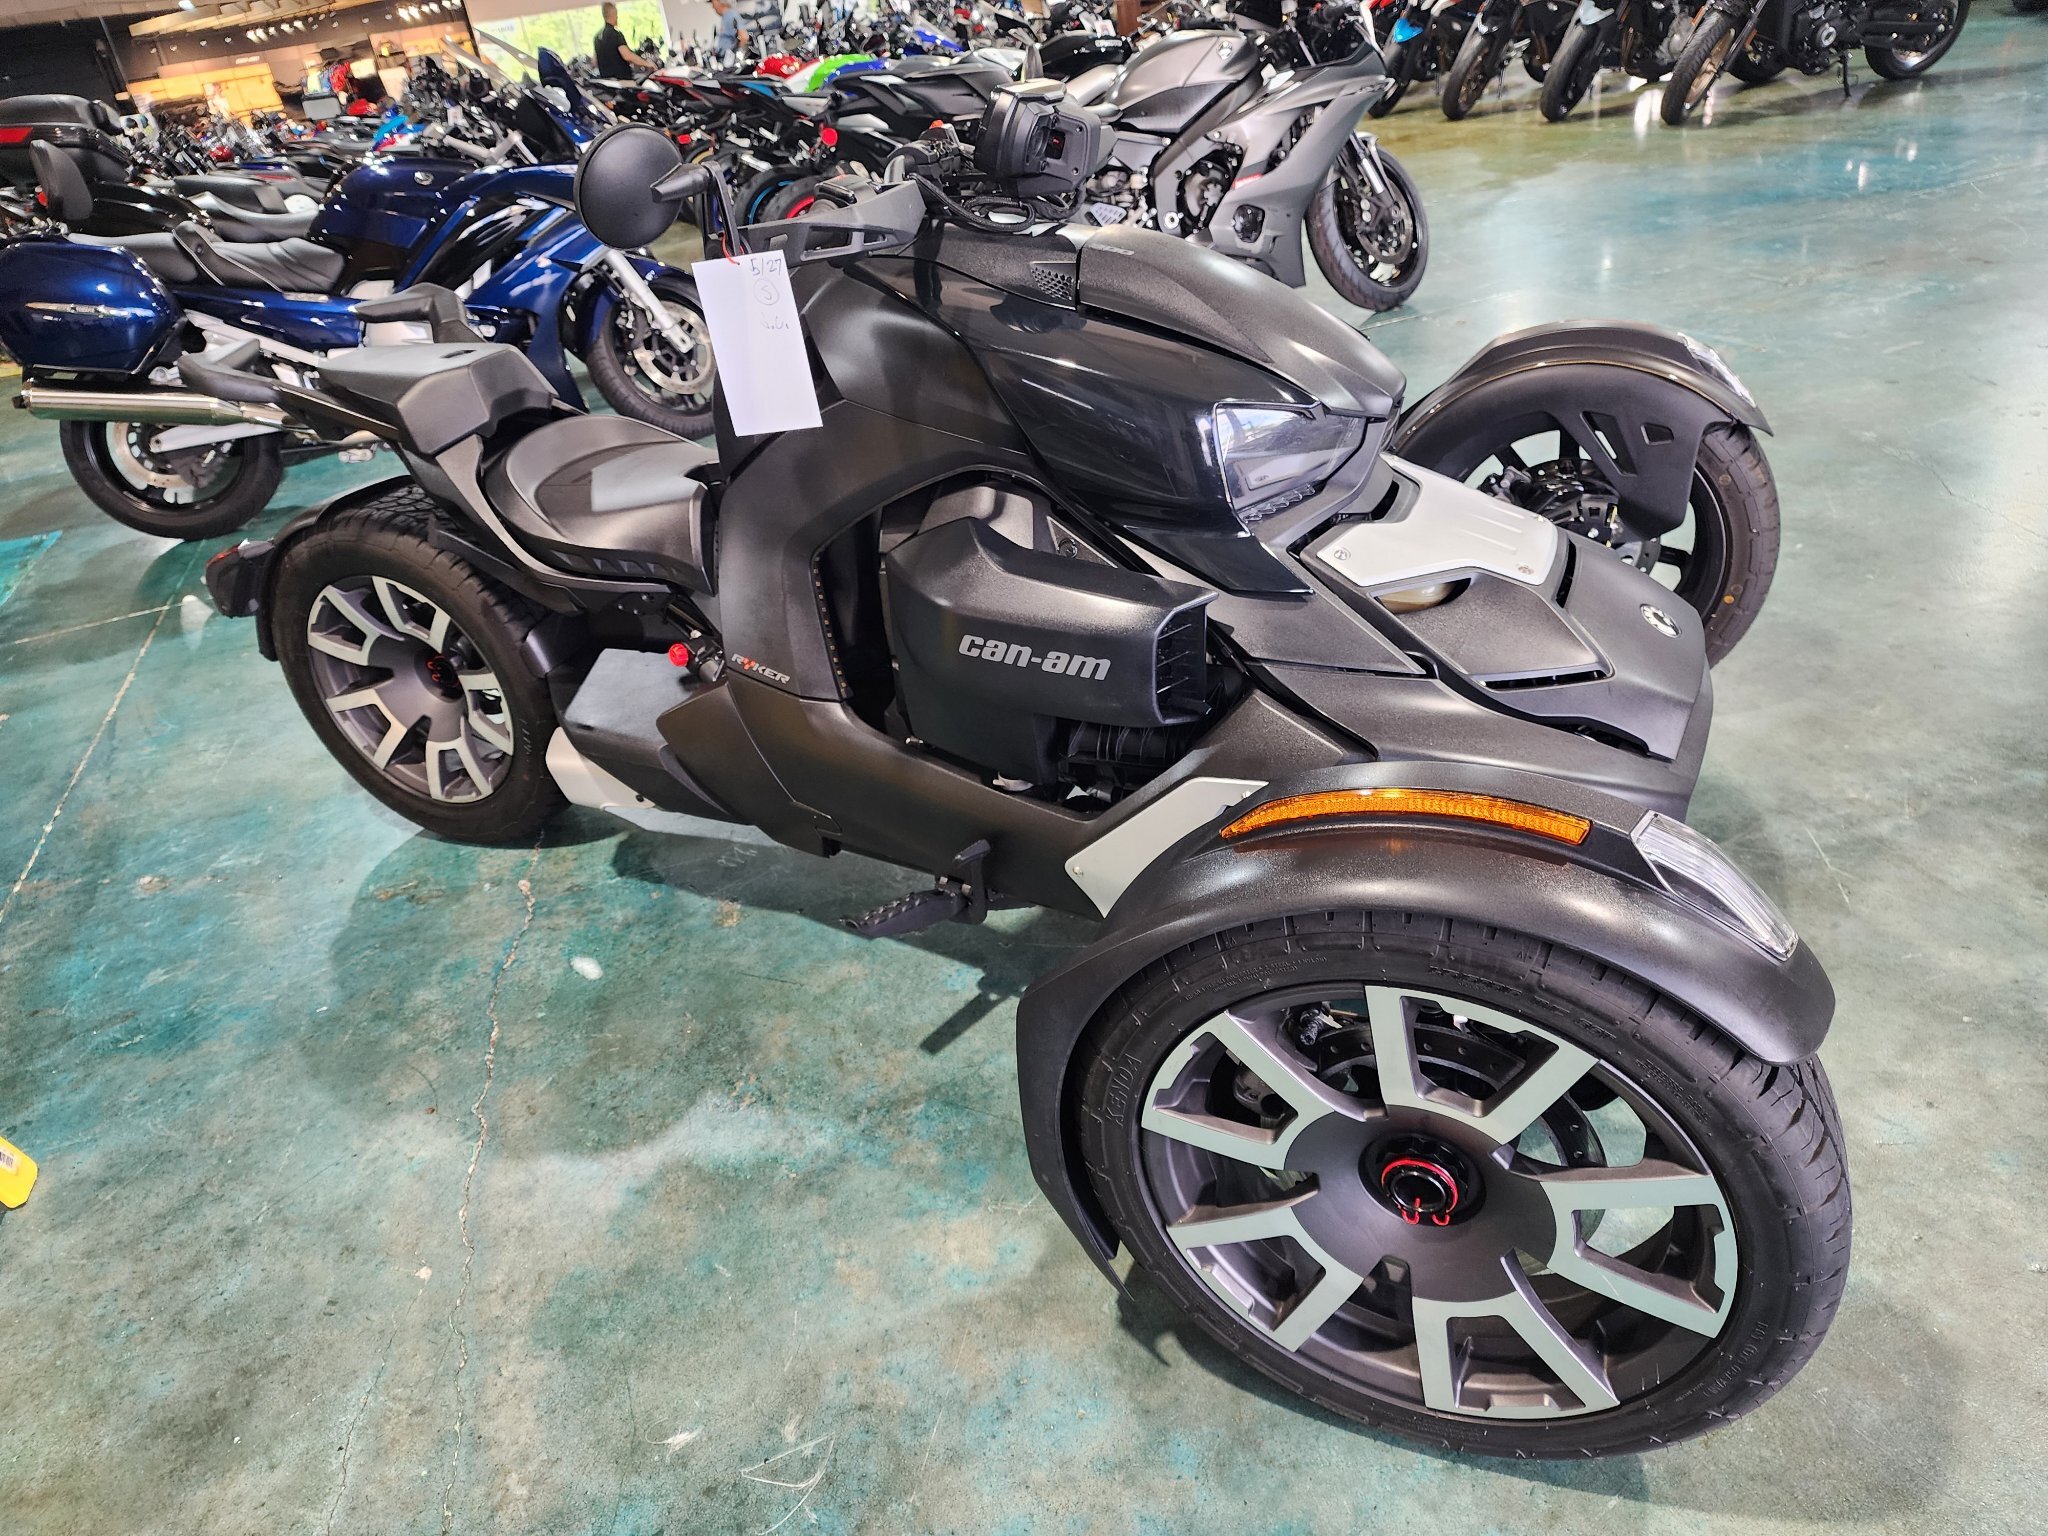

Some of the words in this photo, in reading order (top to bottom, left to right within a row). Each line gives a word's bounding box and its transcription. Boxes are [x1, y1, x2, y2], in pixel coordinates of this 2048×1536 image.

[750, 257, 782, 277] 5/27
[731, 653, 791, 685] RYKER
[958, 634, 1112, 681] can-am
